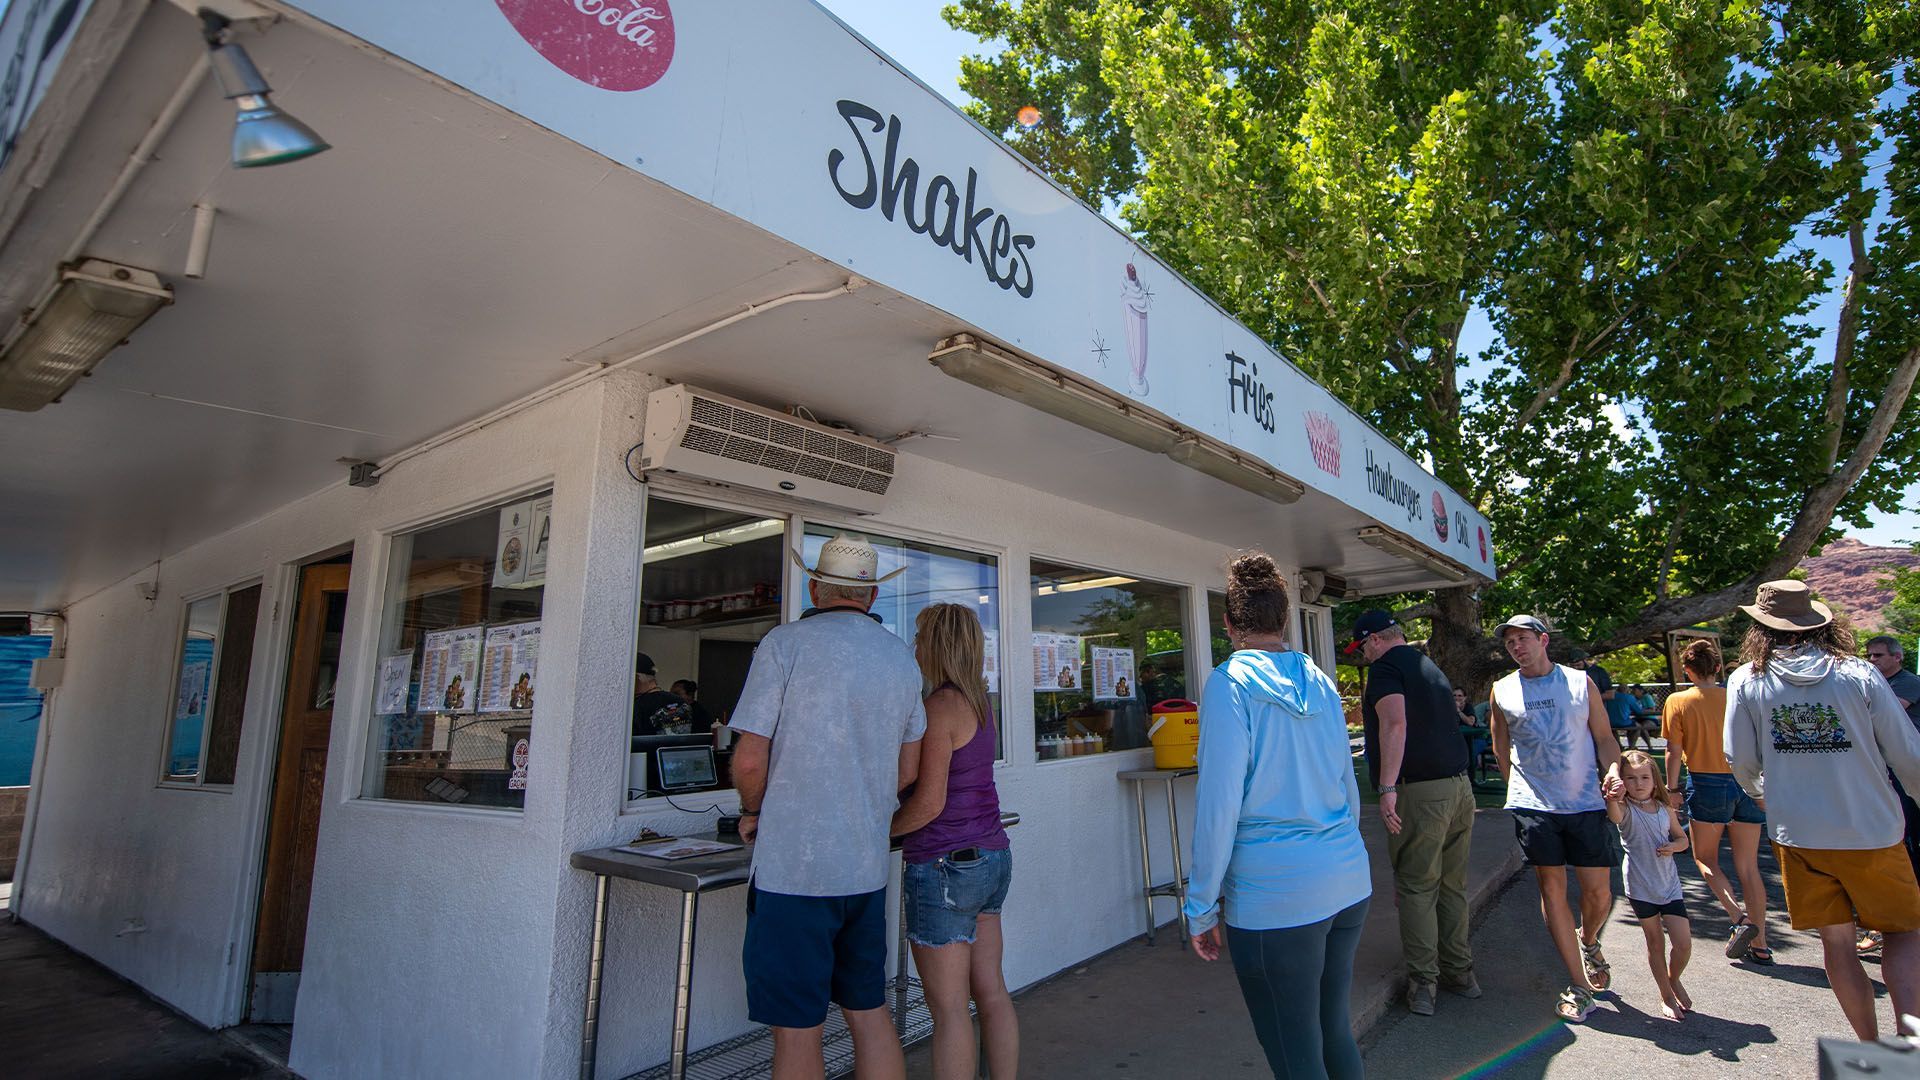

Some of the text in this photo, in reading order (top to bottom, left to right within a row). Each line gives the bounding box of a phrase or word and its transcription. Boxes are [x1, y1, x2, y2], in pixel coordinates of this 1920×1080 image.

[828, 100, 1036, 298] Shakes
[1225, 350, 1275, 434] Fries
[1365, 448, 1422, 523] Hamburgers
[1455, 511, 1470, 549] Chili
